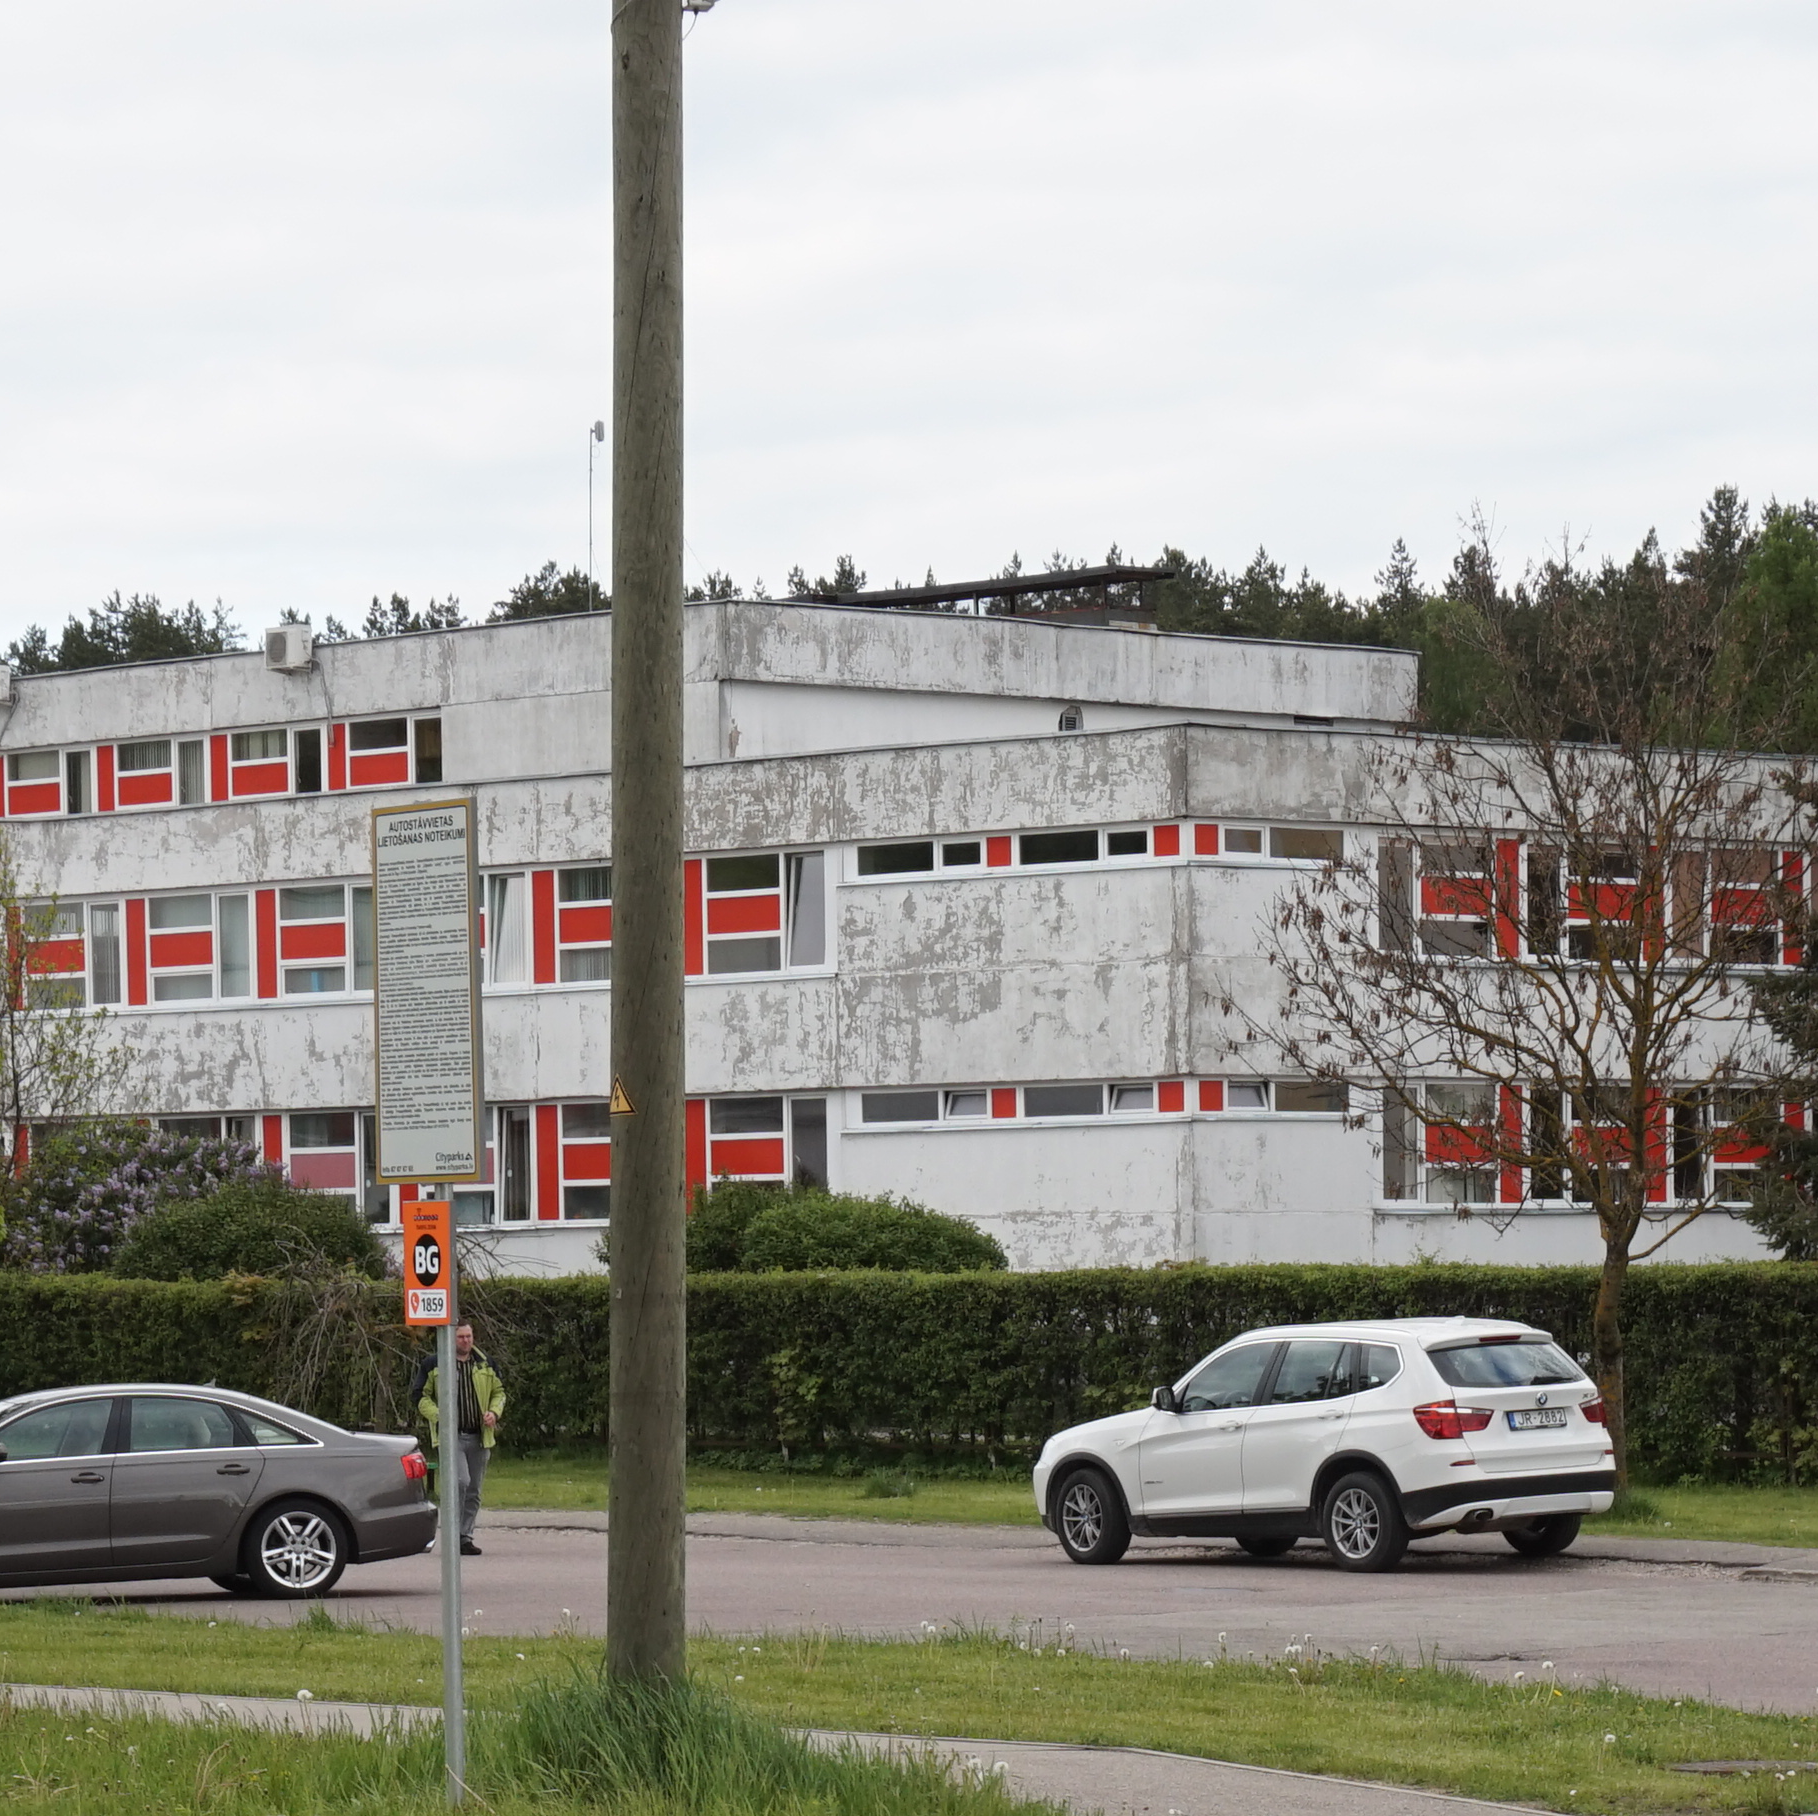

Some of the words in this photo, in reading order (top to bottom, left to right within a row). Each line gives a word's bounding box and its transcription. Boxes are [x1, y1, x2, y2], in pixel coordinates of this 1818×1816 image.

[389, 815, 453, 833] AUTOSTĀVVIETAS
[378, 832, 423, 848] LIETOŠANAS
[424, 828, 466, 843] NOTEIKUMI
[435, 1150, 464, 1164] Cityparks
[415, 1245, 439, 1274] BG
[421, 1297, 444, 1313] 1859
[1518, 1410, 1564, 1426] JR-2882
